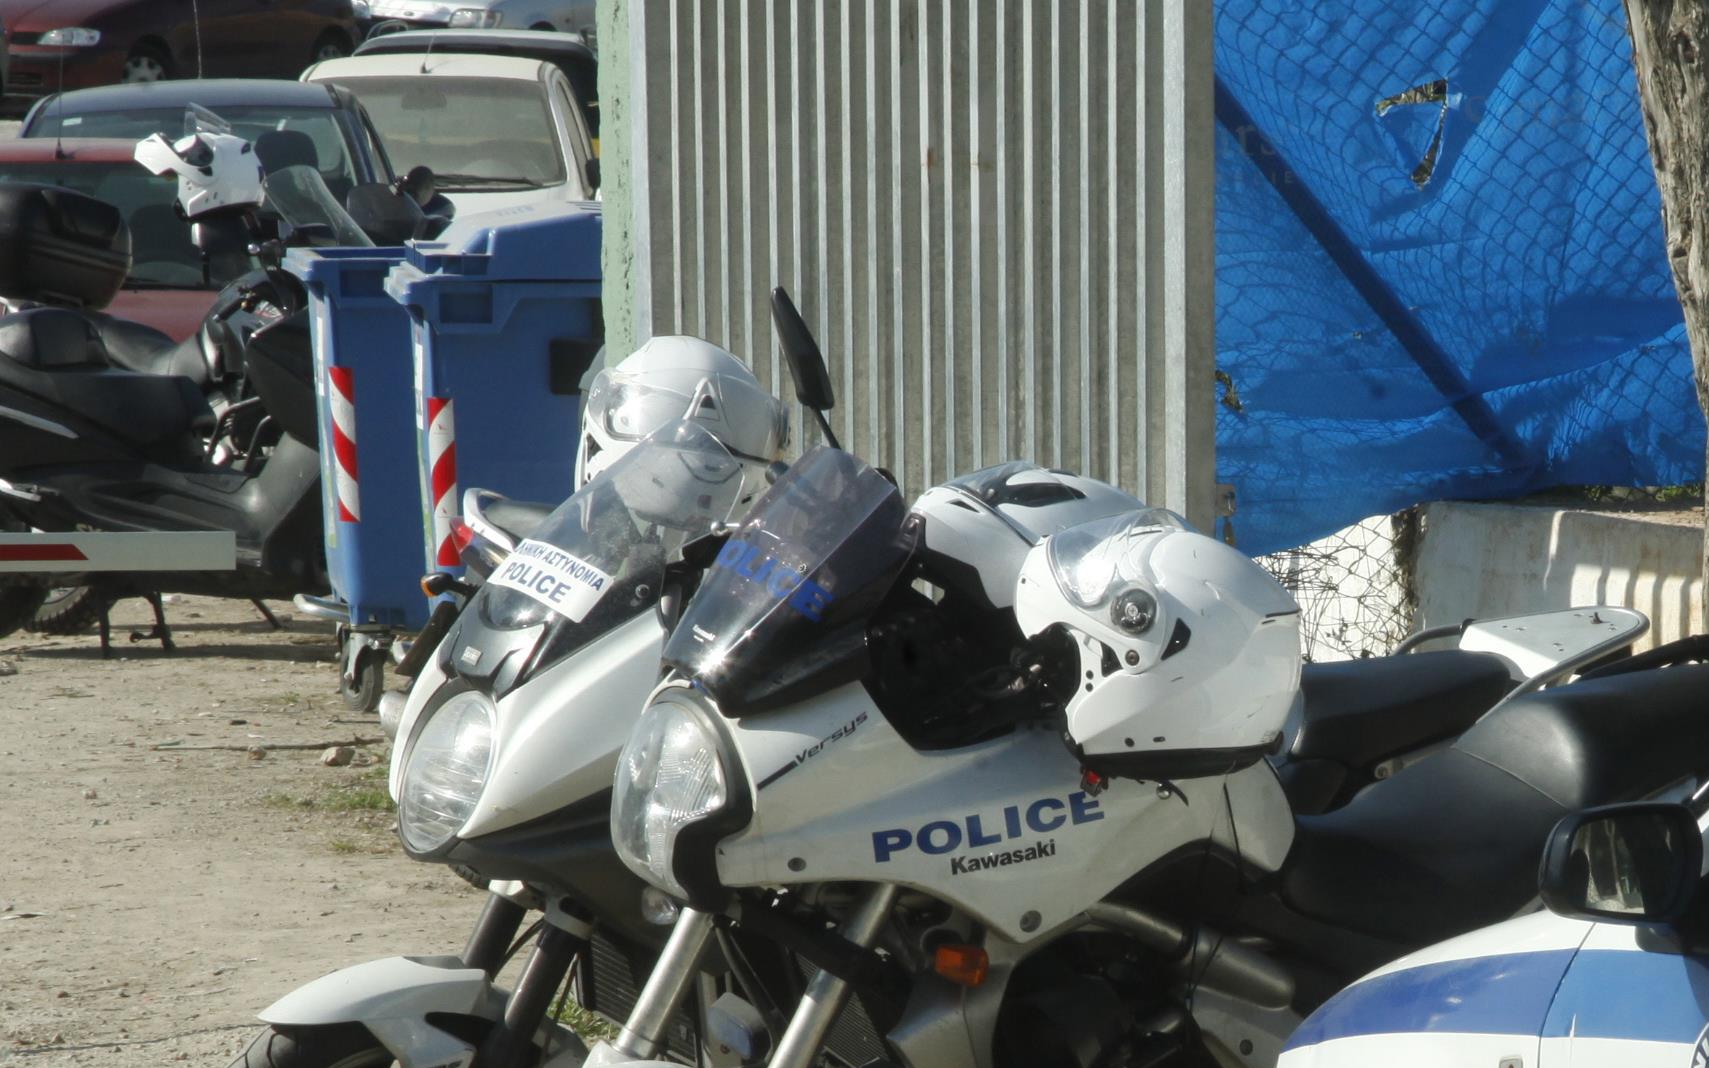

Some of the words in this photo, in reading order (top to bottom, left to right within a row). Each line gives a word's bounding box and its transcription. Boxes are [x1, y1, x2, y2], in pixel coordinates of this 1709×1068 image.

[501, 562, 572, 603] POLICE
[795, 711, 868, 764] Versys
[872, 791, 1105, 863] POLICE
[951, 839, 1057, 875] Kawasaki
